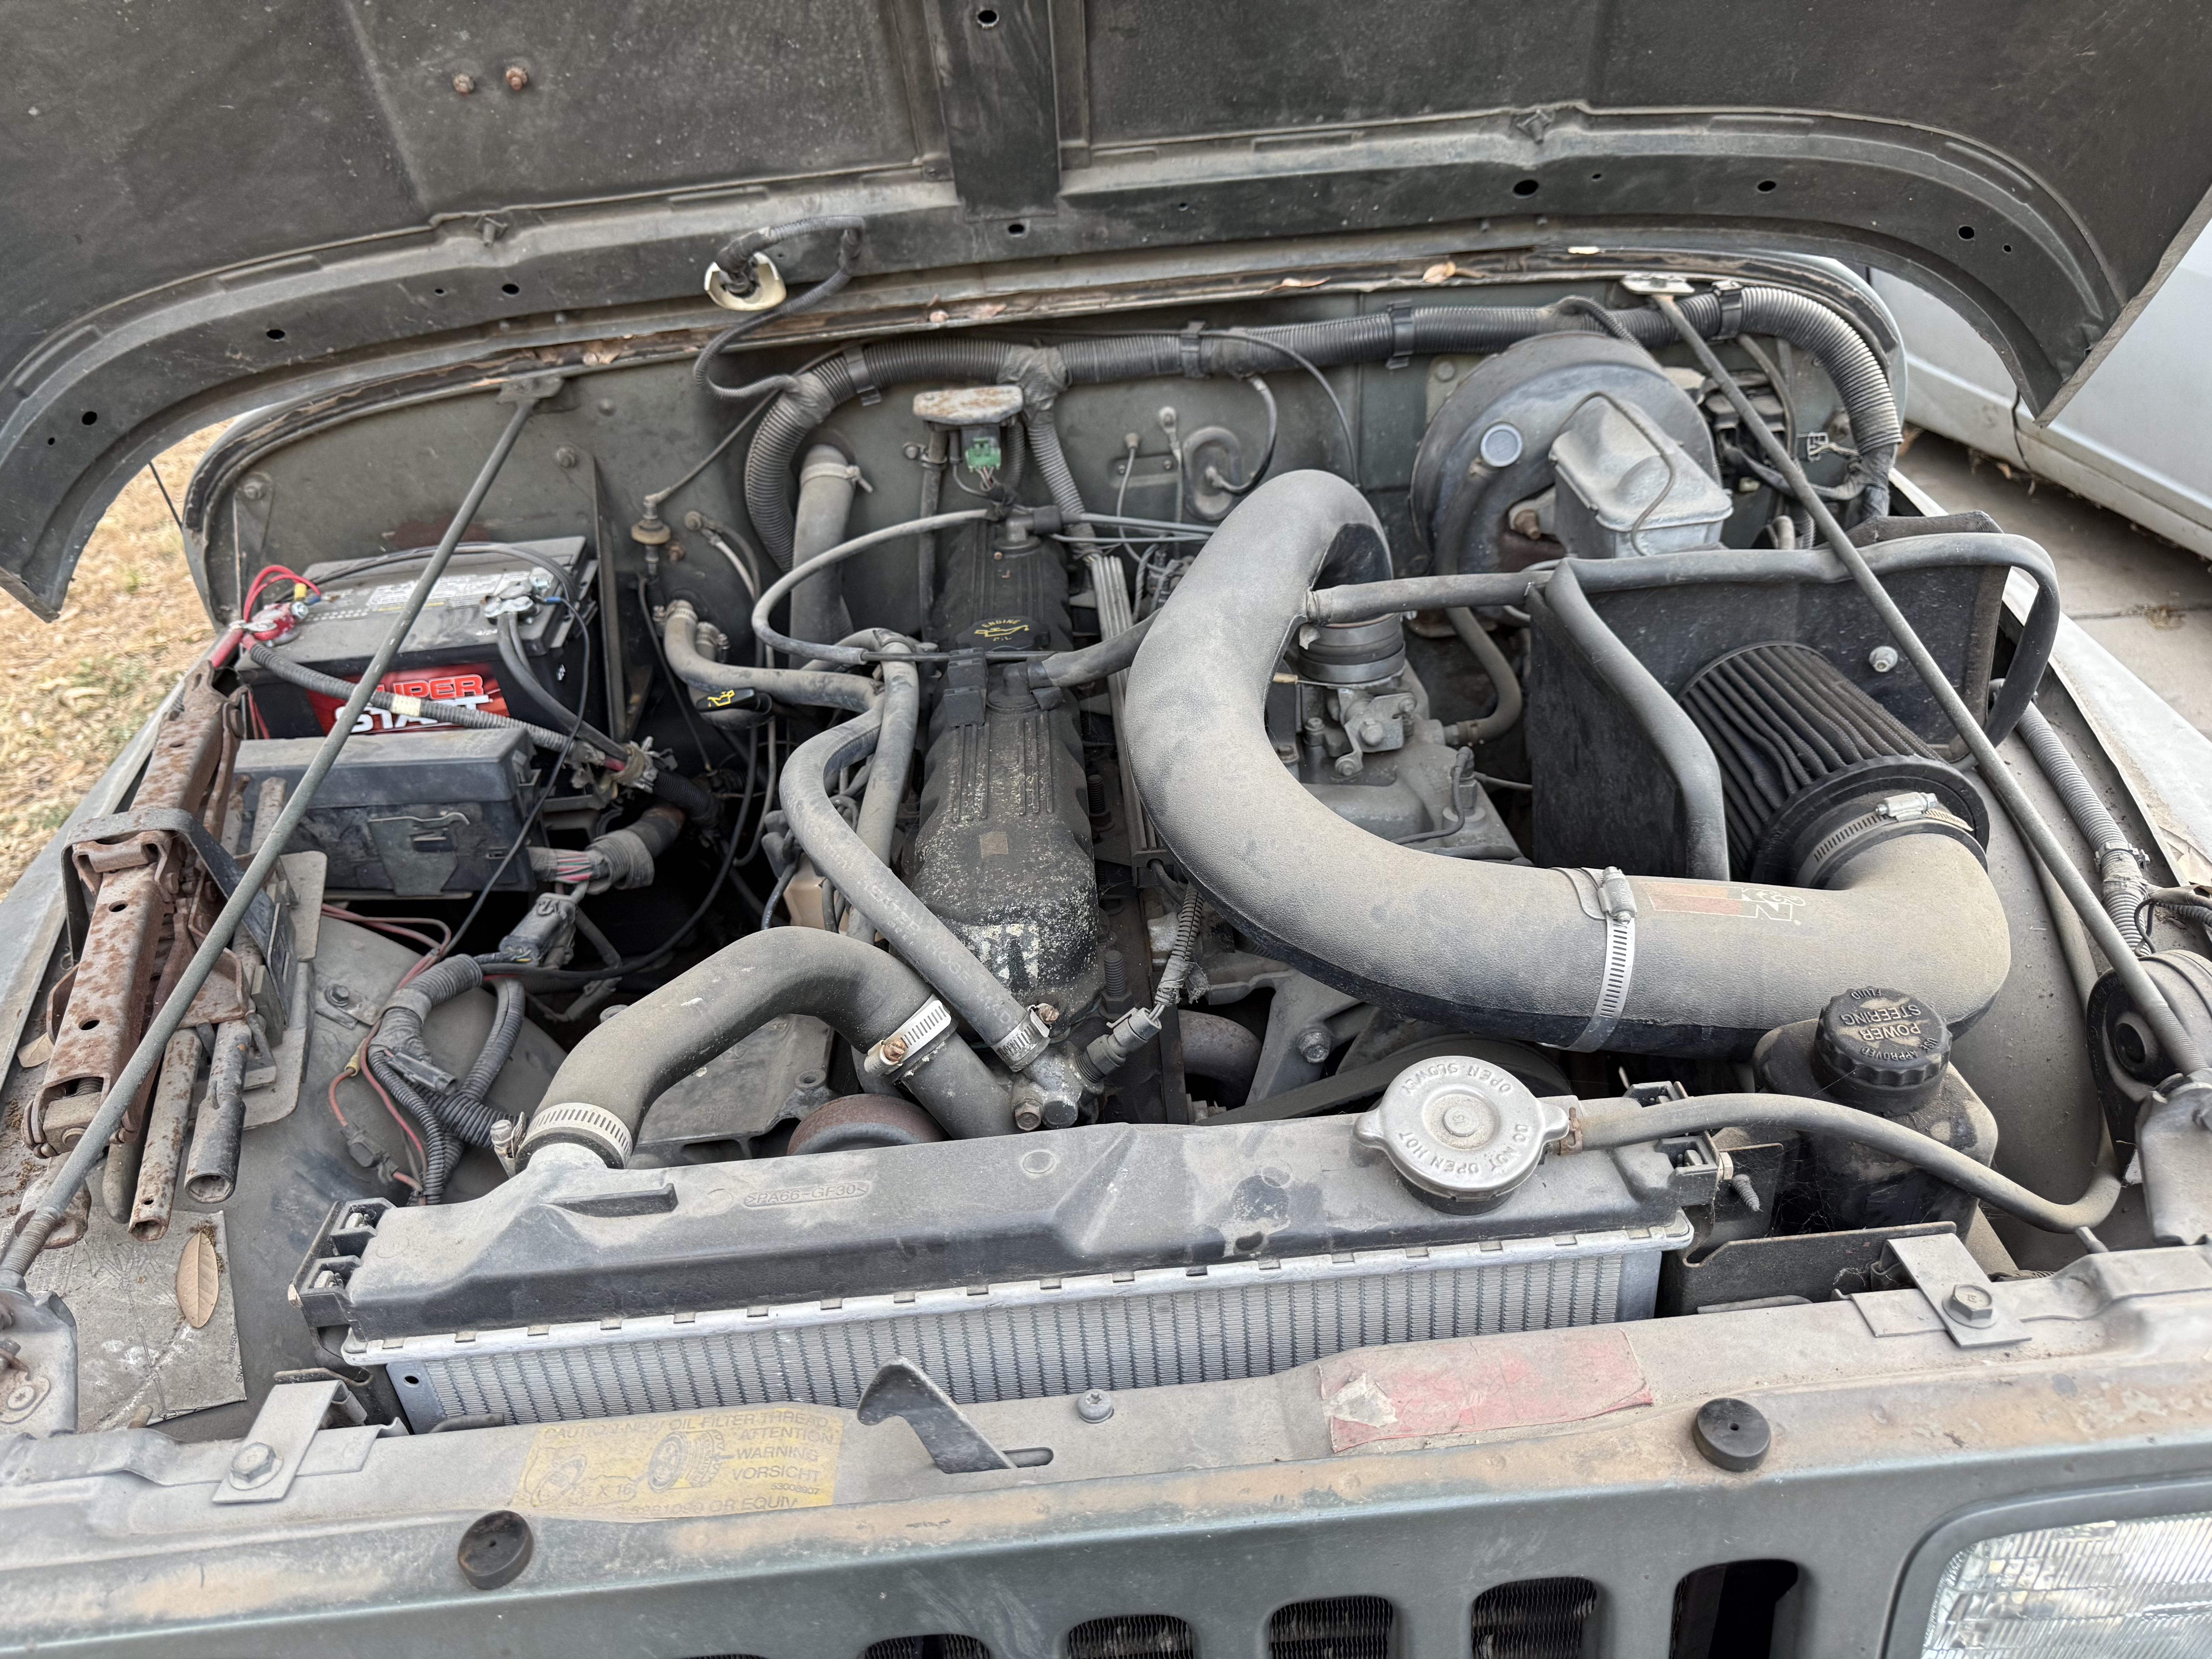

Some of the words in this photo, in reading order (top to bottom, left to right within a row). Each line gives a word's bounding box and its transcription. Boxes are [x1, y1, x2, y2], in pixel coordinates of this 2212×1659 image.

[981, 620, 1021, 628] ENGINE
[926, 940, 971, 985] HOSE
[1851, 988, 1882, 1000] FLUID
[1840, 1004, 1922, 1026] STEERING
[1858, 1023, 1922, 1042] POWER
[1860, 1046, 1919, 1061] APPROVED
[1920, 1038, 1939, 1053] USE
[1400, 1063, 1459, 1096] SLOWLY
[1466, 1065, 1513, 1094] OPEN
[1512, 1123, 1531, 1147] DO
[1399, 1132, 1431, 1160] HOT
[1431, 1154, 1482, 1175] OPEN
[1489, 1144, 1523, 1173] NOT
[669, 1415, 696, 1431] OIL
[700, 1412, 754, 1429] FILTER
[759, 1408, 828, 1428] THREAD
[738, 1426, 834, 1444] ATTENTION
[737, 1446, 819, 1462] WARNING
[732, 1465, 822, 1482] VORSICHT
[709, 1498, 735, 1513] OR
[741, 1495, 798, 1510] EQUIV
